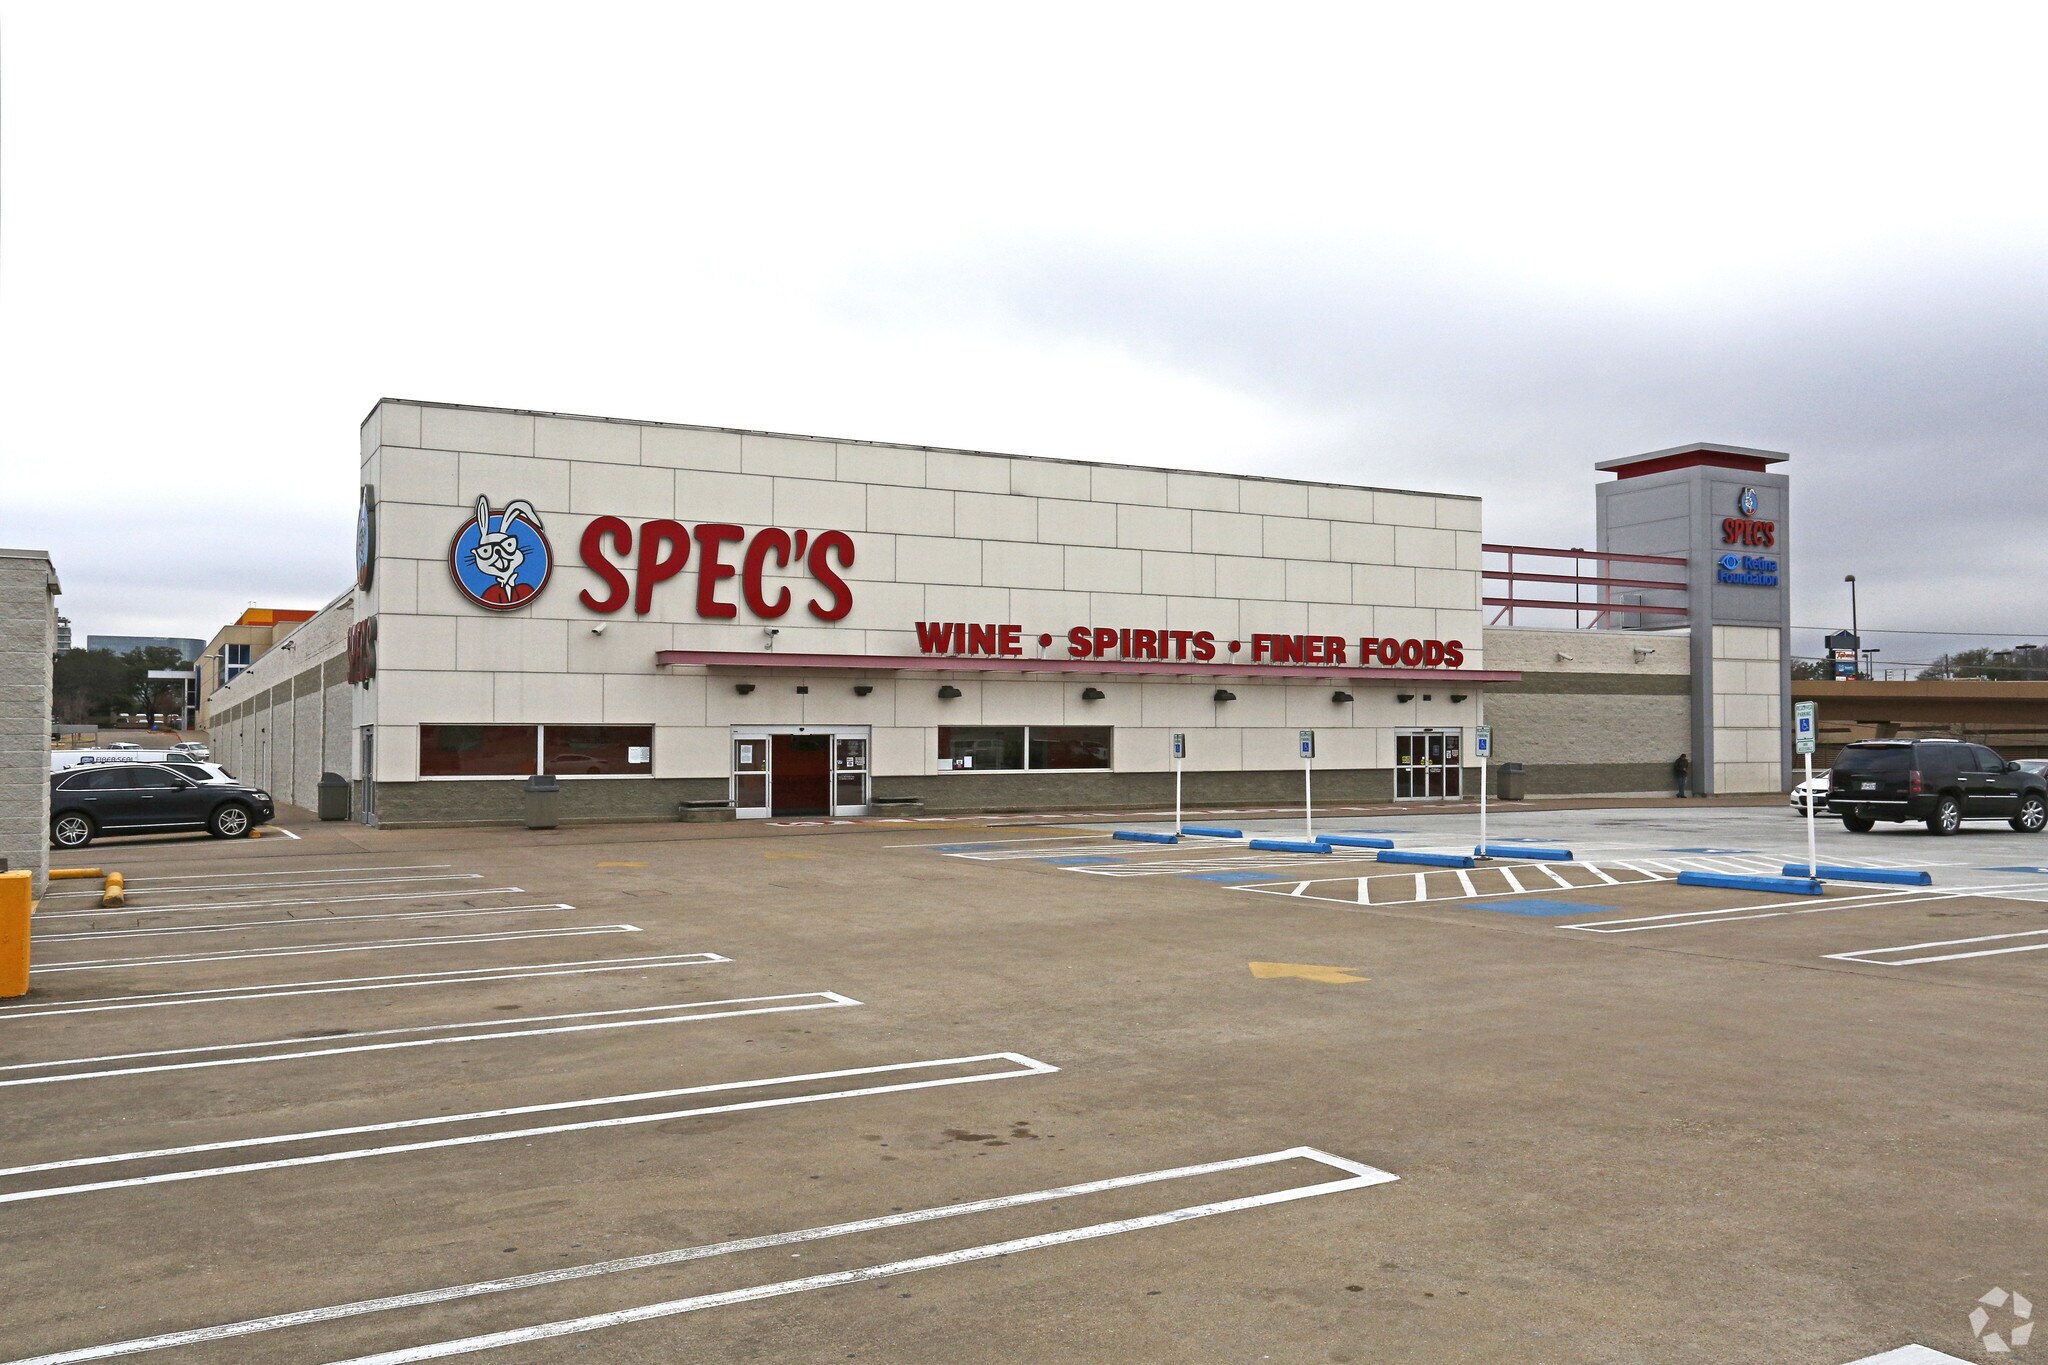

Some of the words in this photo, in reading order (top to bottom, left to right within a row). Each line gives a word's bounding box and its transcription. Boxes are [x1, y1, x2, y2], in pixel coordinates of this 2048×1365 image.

[1722, 517, 1775, 547] SPEC'S
[580, 515, 855, 621] SPEC'S
[1718, 570, 1778, 586] Foundation
[1743, 556, 1777, 571] Retina
[916, 621, 1022, 655] WINE
[1067, 626, 1216, 661] SPIRITS
[1251, 633, 1346, 665] FINER
[1359, 637, 1464, 668] FOODS
